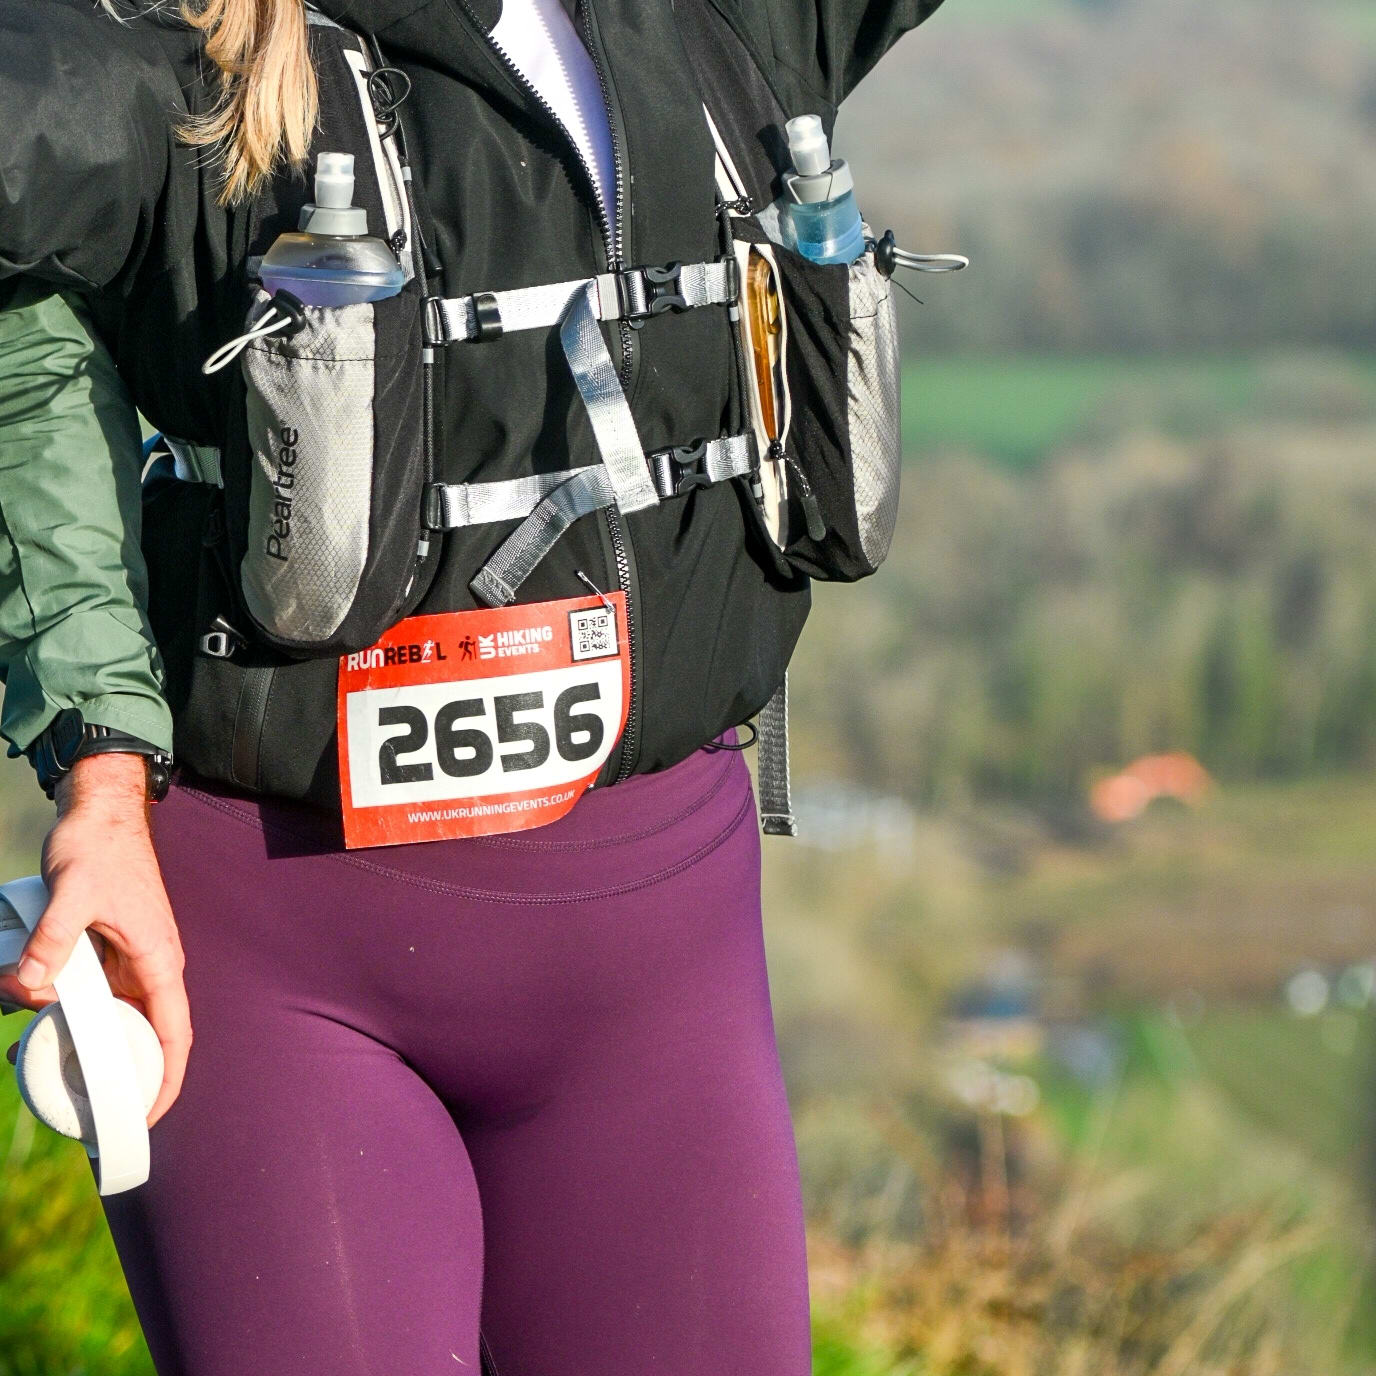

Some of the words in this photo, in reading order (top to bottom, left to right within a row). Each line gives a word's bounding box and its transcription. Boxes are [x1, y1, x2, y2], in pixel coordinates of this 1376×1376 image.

[265, 426, 299, 562] Peartree
[478, 633, 497, 660] UK
[496, 626, 553, 647] HIKING
[497, 643, 540, 658] EVENTS
[378, 682, 605, 785] 2656
[407, 789, 576, 823] WWW.UKRUNNINGEVENTS.CO.UK
